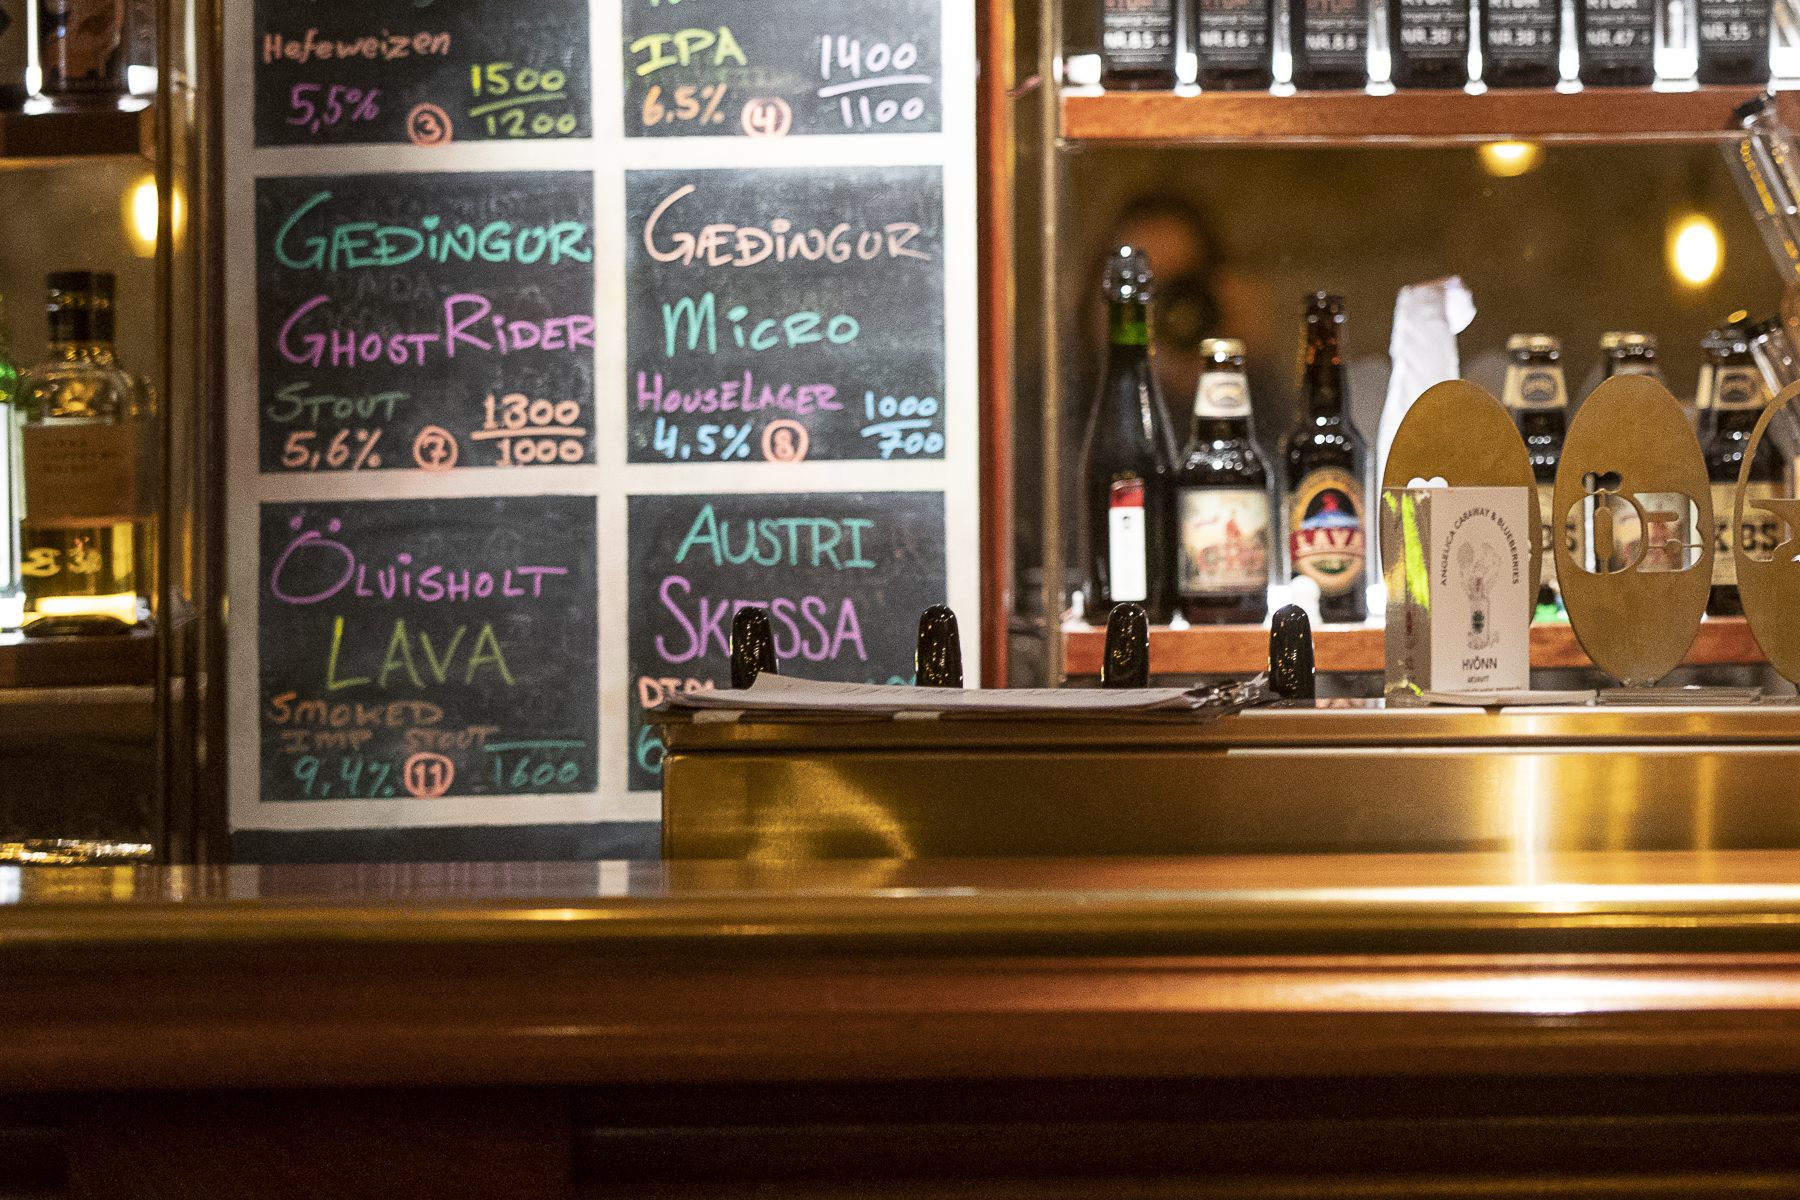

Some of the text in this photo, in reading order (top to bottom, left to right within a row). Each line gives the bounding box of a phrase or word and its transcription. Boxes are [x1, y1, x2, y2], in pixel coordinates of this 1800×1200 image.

[629, 25, 748, 76] IPA
[819, 35, 917, 80] 1400
[470, 62, 566, 97] 1500
[486, 109, 577, 137] 1200
[839, 96, 925, 128] 1100
[279, 295, 439, 367] GHOST
[864, 390, 938, 420] 1000
[496, 437, 584, 467] 1000
[877, 428, 945, 460] 700
[675, 502, 876, 570] AUSTRI
[327, 614, 515, 691] LAVA
[268, 692, 444, 727] SMOKED
[494, 756, 580, 788] 1600
